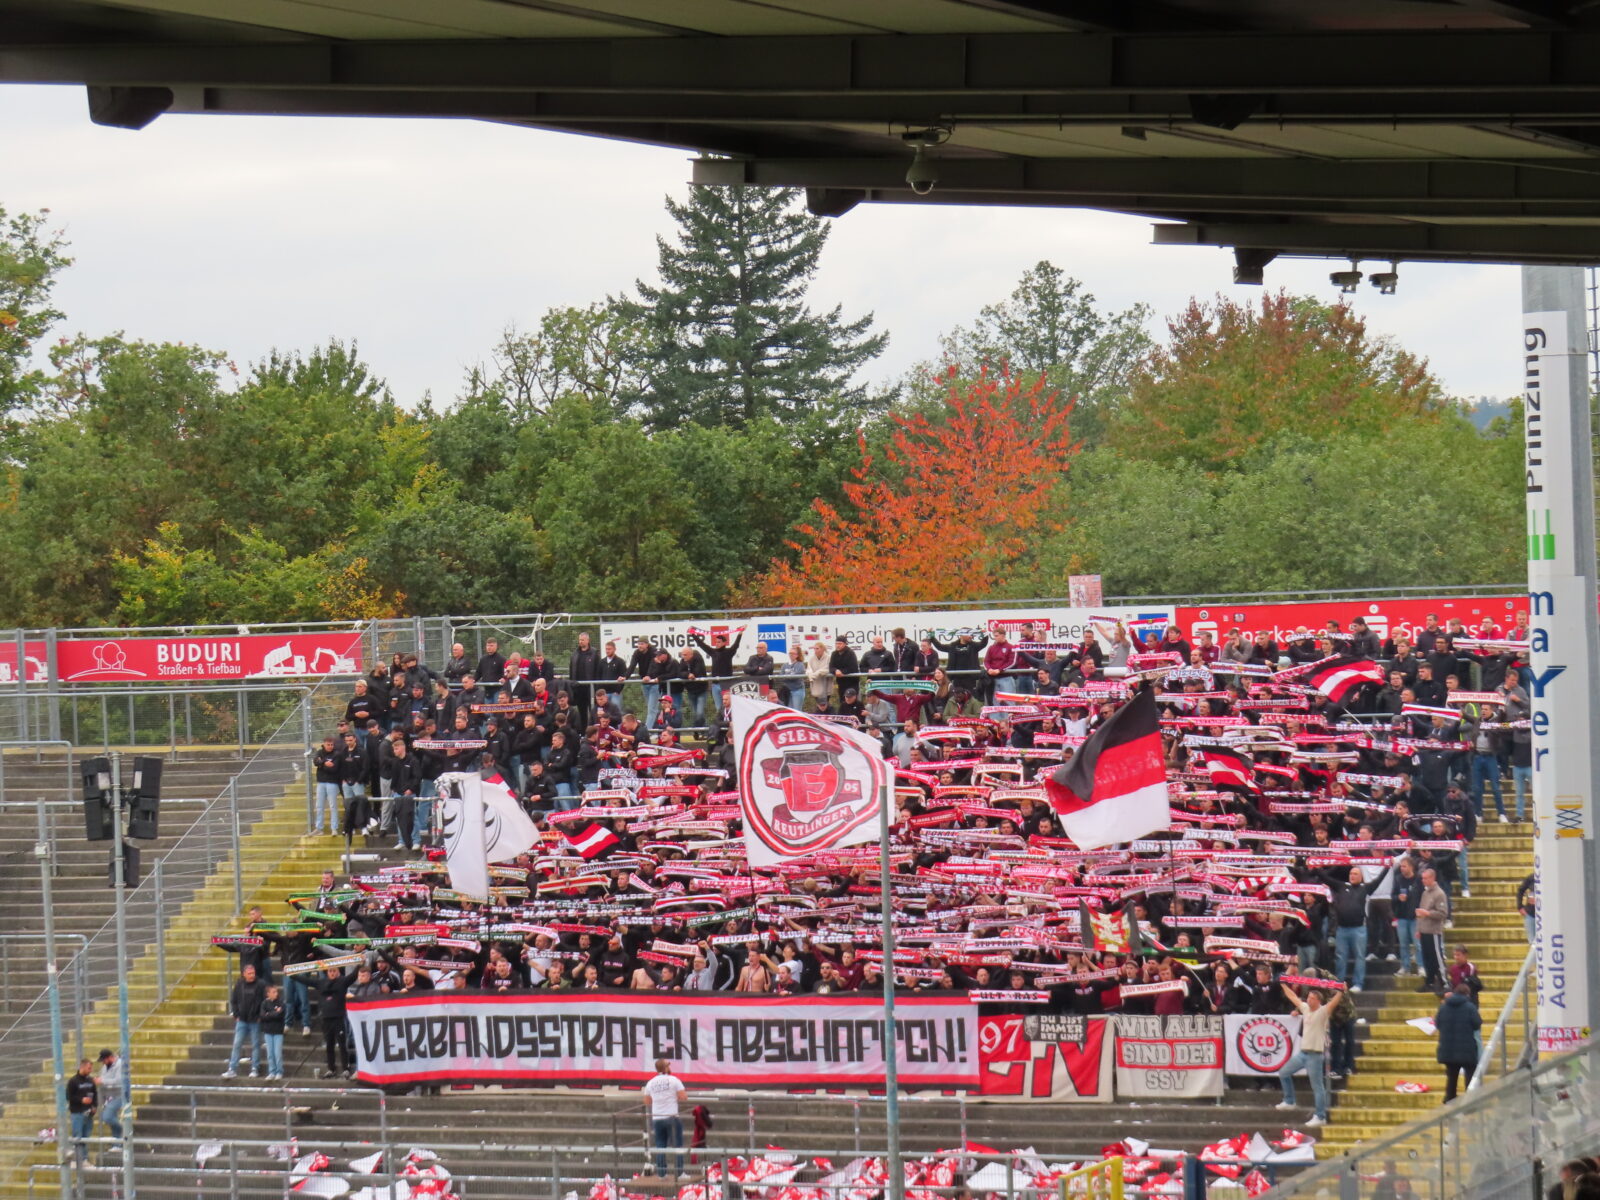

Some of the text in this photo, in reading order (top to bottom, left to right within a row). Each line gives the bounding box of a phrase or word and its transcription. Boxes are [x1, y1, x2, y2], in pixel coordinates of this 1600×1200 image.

[1524, 327, 1547, 493] Prinzing
[758, 631, 786, 640] ZEISS
[157, 642, 241, 662] BUDURI
[206, 663, 241, 674] Tiefbau
[731, 684, 757, 695] SSV
[773, 807, 849, 838] REUTLINGEN
[863, 912, 897, 921] BLOK
[812, 934, 852, 944] BLOCK
[1548, 933, 1566, 1009] Aalen
[1040, 1015, 1084, 1024] DU BIST
[1040, 1024, 1083, 1033] IMMER
[1116, 1014, 1162, 1039] WIR
[1165, 1014, 1222, 1039] ALLE
[360, 1014, 967, 1063] VERBANDSSTRAFEN ABSCHAFFEN!
[979, 1018, 1024, 1054] 97
[1040, 1032, 1057, 1040] BEI
[1122, 1042, 1216, 1066] SIND DER
[1145, 1069, 1188, 1091] SSV
